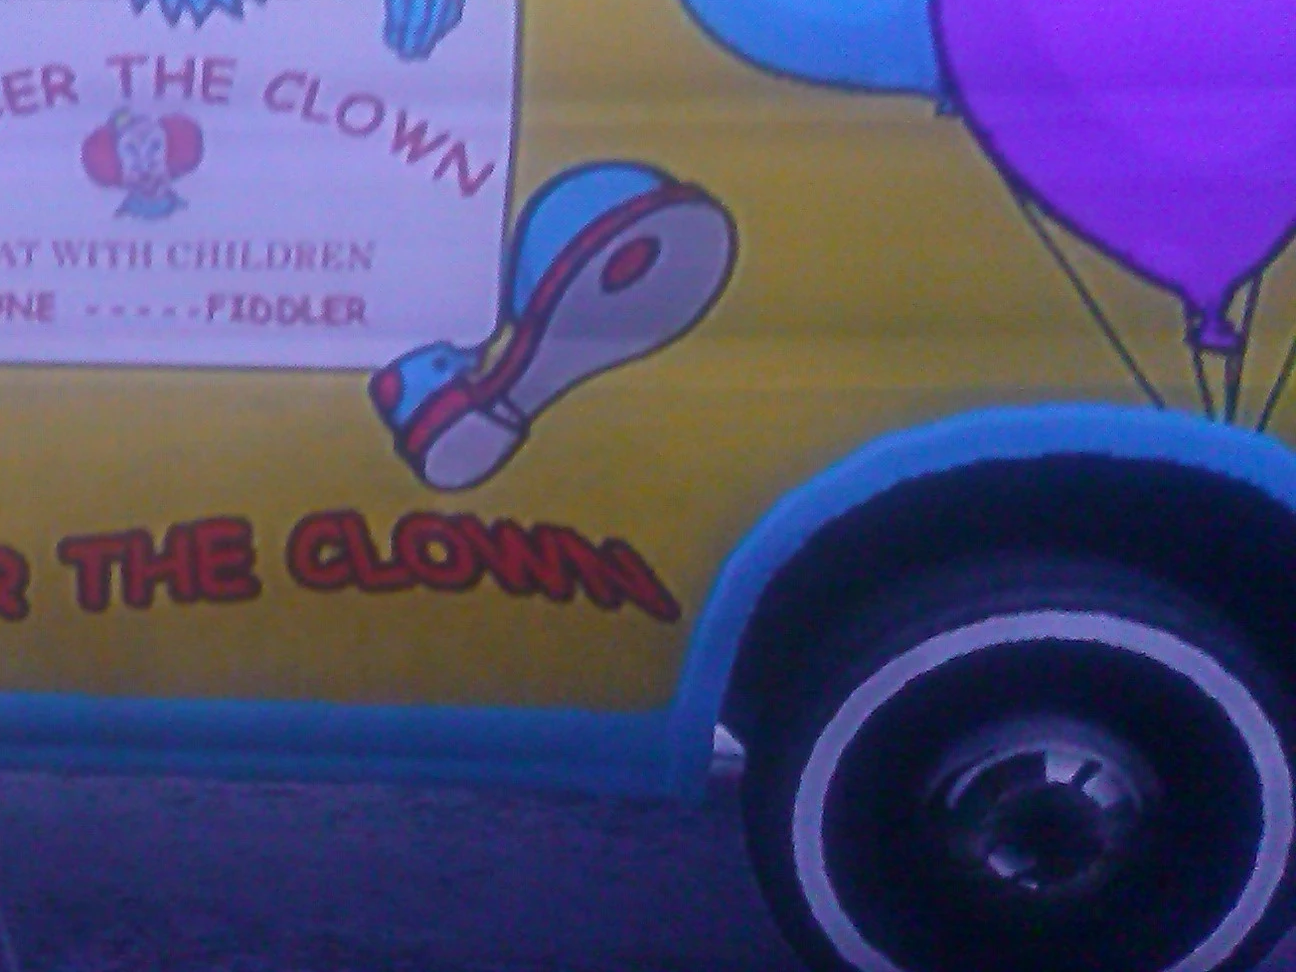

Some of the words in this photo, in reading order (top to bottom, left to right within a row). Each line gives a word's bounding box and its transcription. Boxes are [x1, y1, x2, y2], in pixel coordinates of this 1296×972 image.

[106, 54, 238, 105] THE
[262, 68, 496, 198] CLOWN
[51, 239, 154, 271] WITH
[165, 240, 377, 271] CHILDREN
[206, 292, 366, 326] FIDDLER
[55, 514, 263, 614] THE
[285, 508, 682, 624] CLOWN
